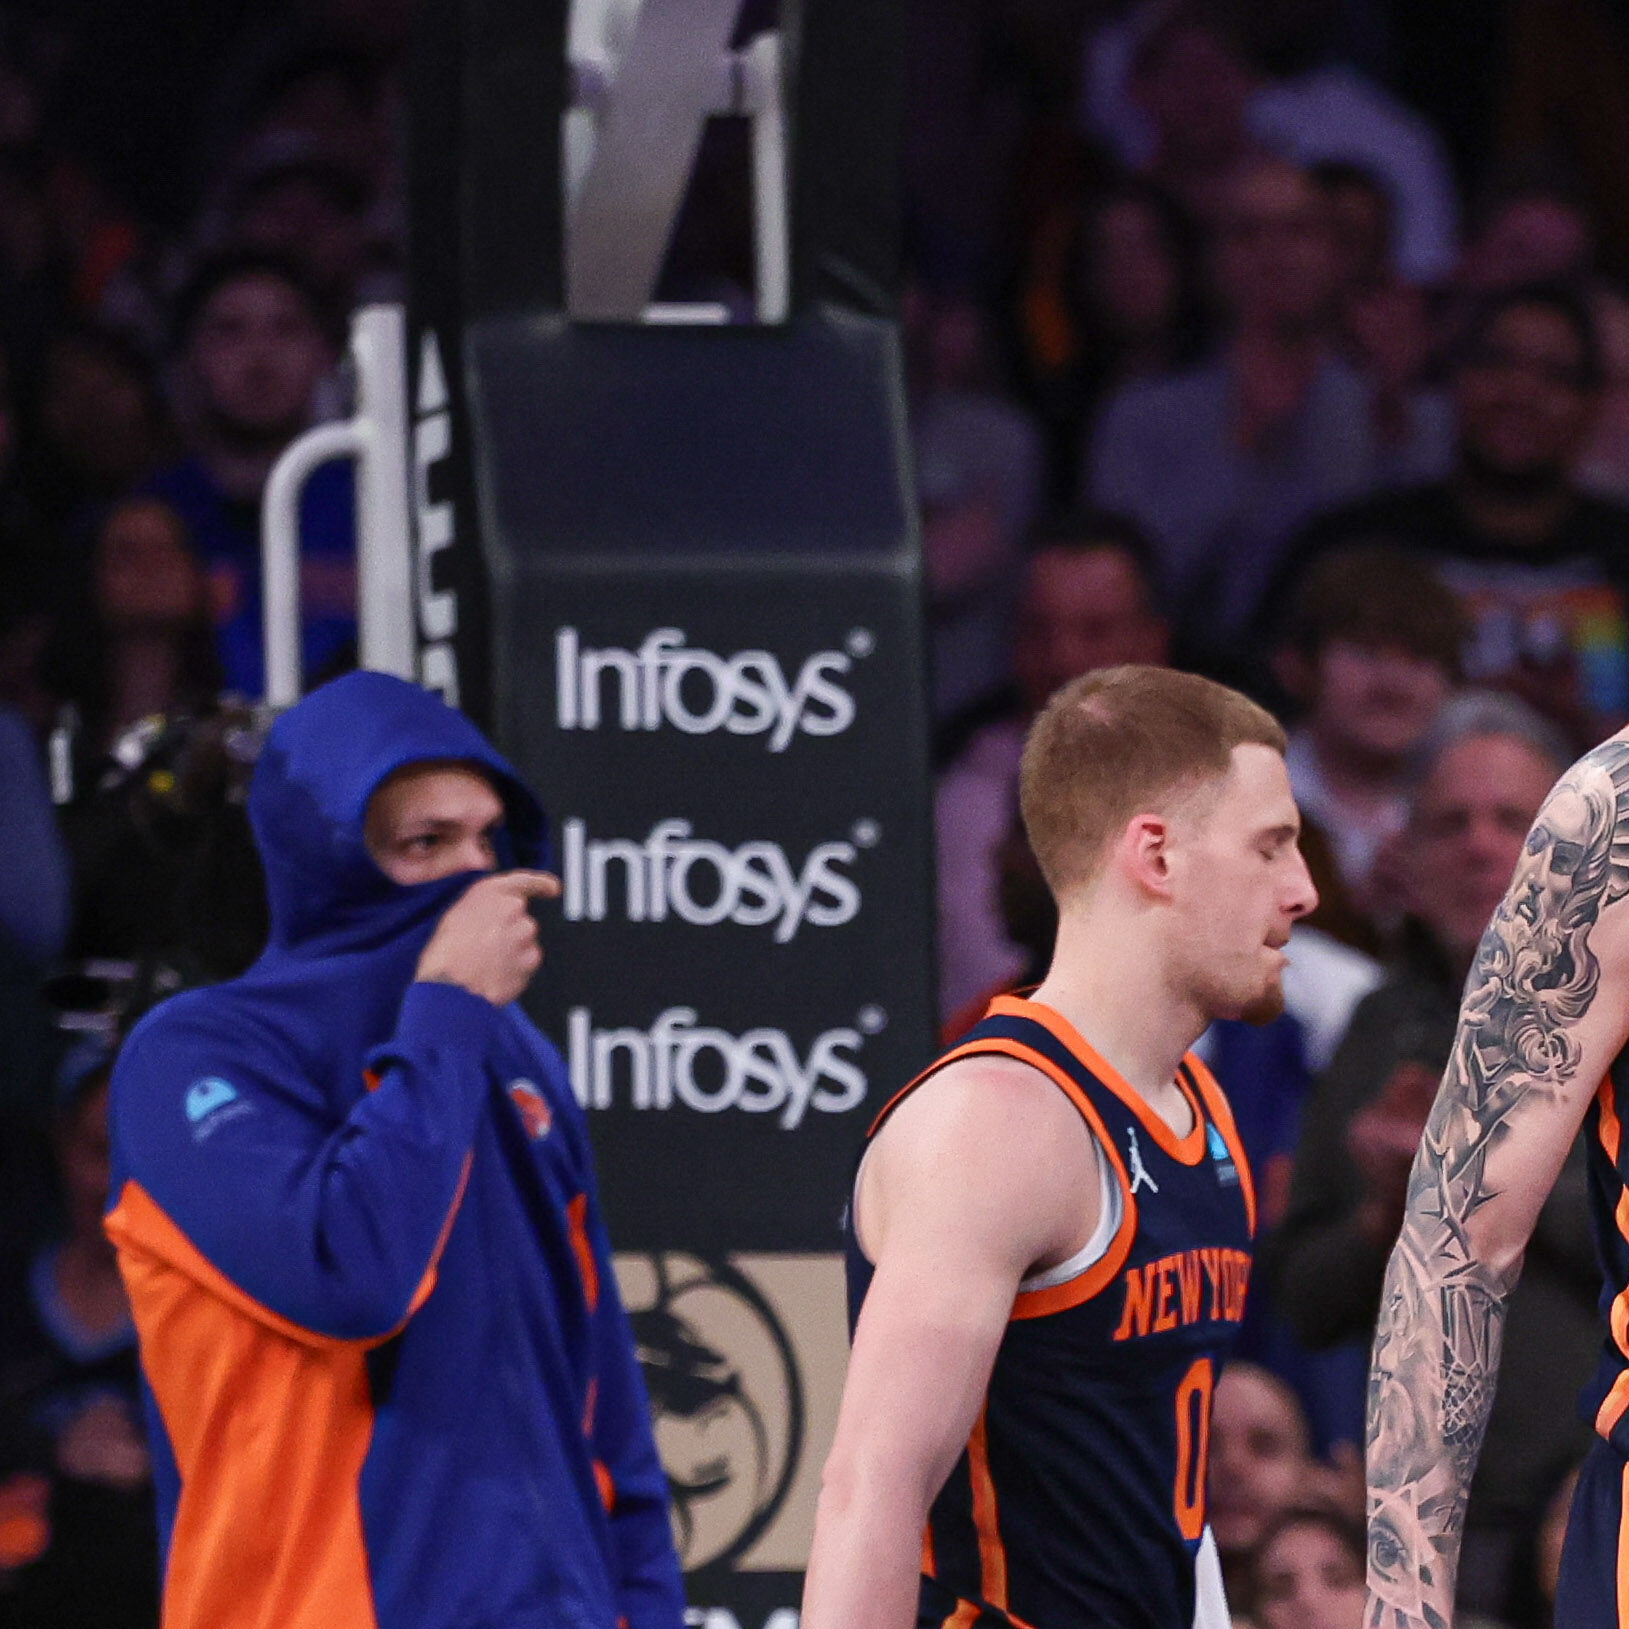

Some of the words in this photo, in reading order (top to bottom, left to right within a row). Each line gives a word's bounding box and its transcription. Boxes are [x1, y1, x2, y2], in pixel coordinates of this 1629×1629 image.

[555, 625, 857, 752] Infosys
[562, 817, 862, 943] Infosys
[567, 1006, 869, 1130] Infosys
[1113, 1250, 1200, 1341] NEW
[1173, 1356, 1214, 1541] 0
